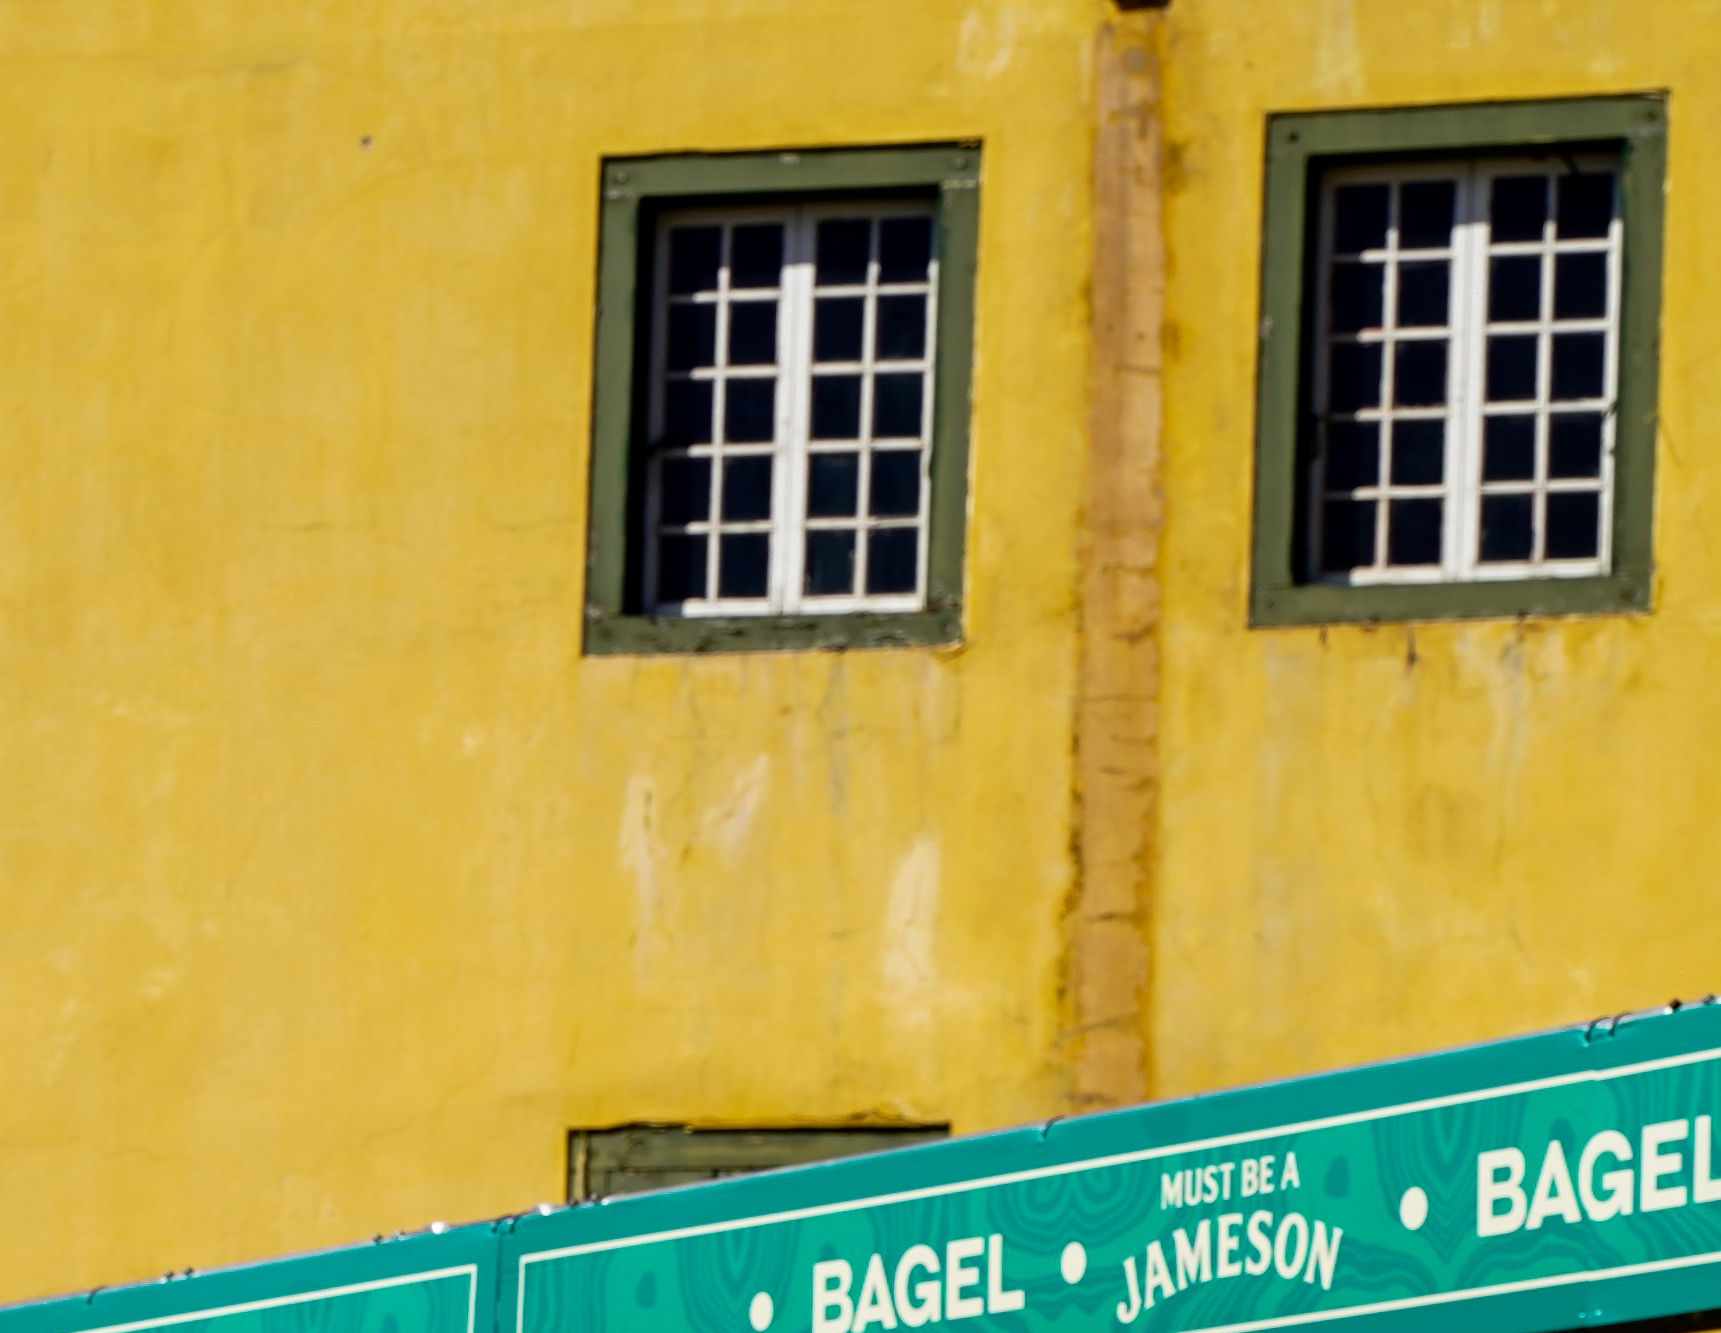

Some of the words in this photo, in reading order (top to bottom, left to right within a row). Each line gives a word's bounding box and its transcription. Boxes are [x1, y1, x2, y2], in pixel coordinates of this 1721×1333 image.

[1161, 1162, 1235, 1210] MUST
[1240, 1155, 1276, 1198] BE
[1279, 1151, 1300, 1190] A
[1476, 1114, 1721, 1238] BAGEL
[1116, 1209, 1344, 1324] JAMESON
